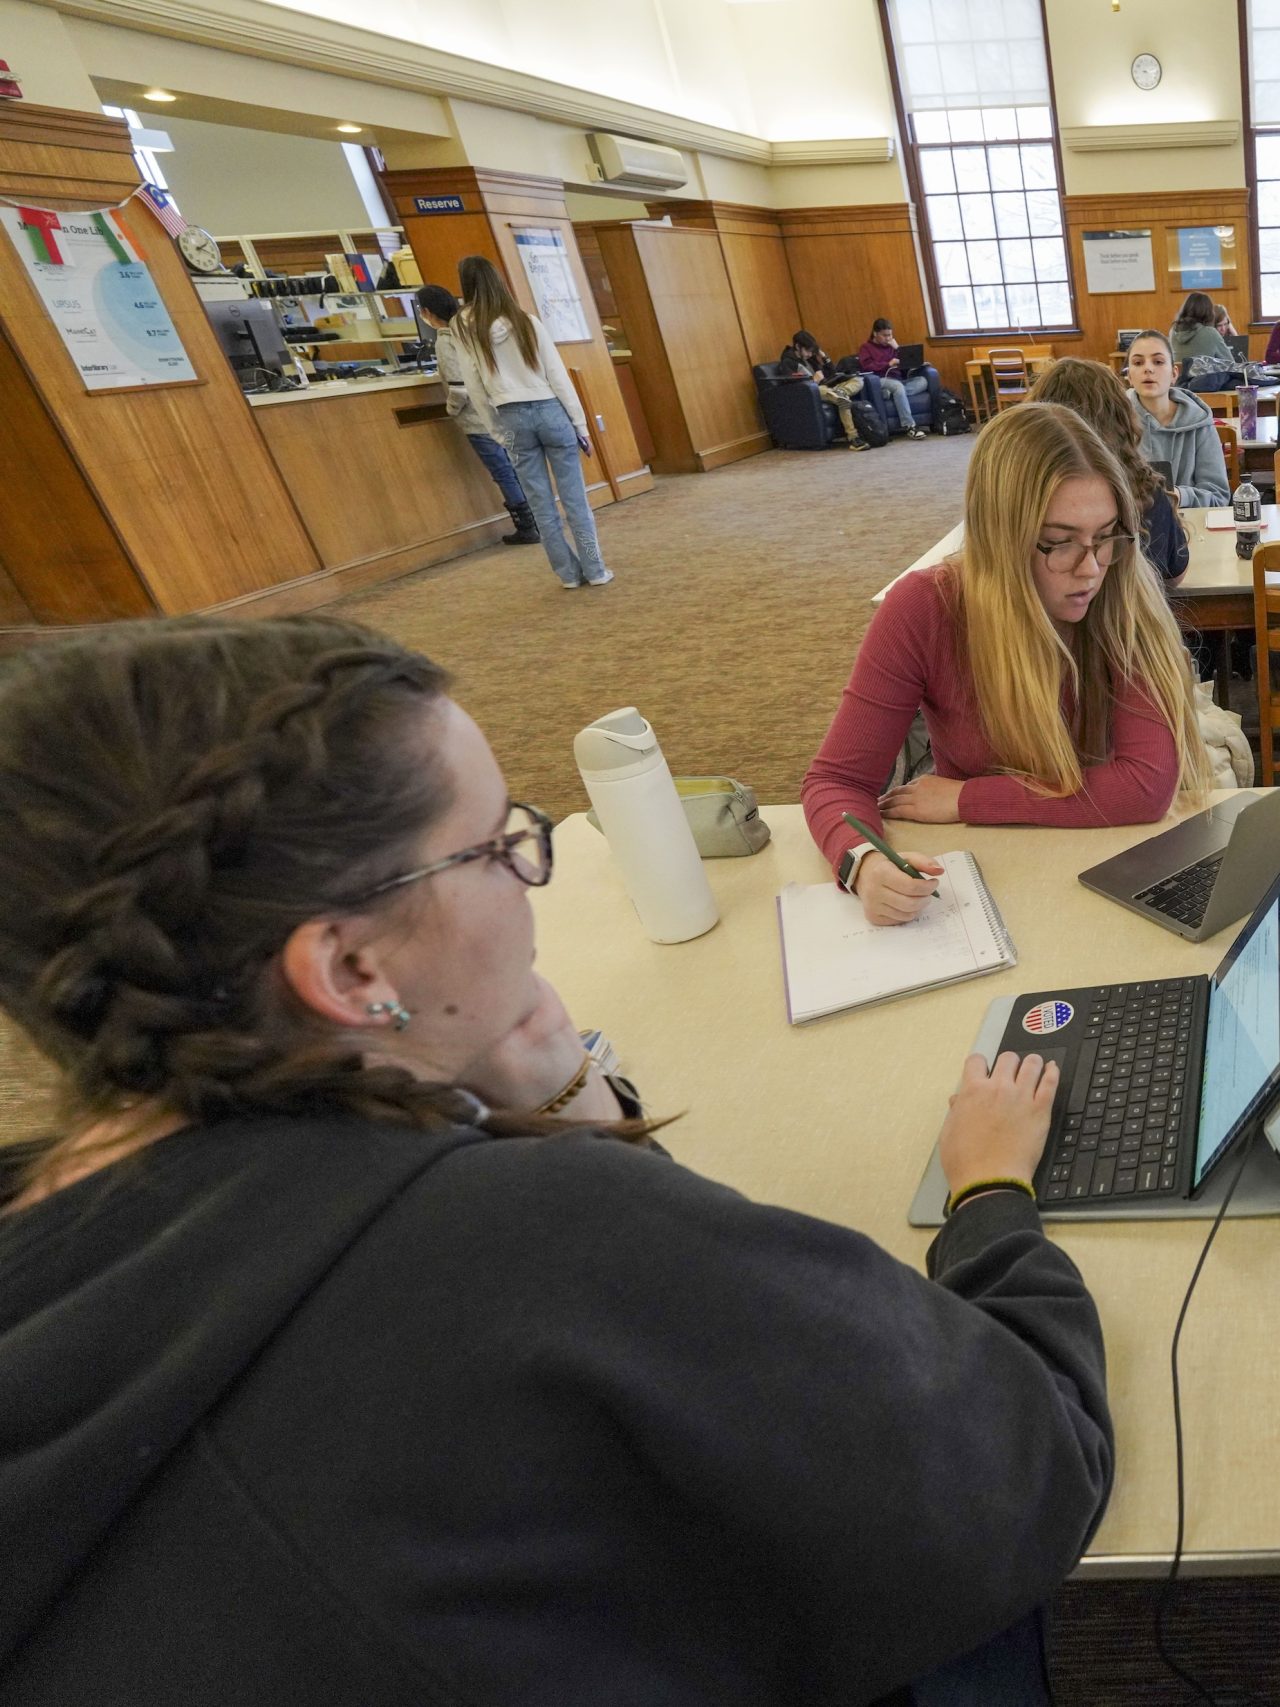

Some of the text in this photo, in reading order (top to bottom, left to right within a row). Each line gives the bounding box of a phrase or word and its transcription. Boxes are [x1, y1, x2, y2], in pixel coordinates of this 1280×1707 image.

[417, 199, 460, 209] Reserve
[70, 225, 88, 235] One
[1043, 1007, 1055, 1029] VOTED
